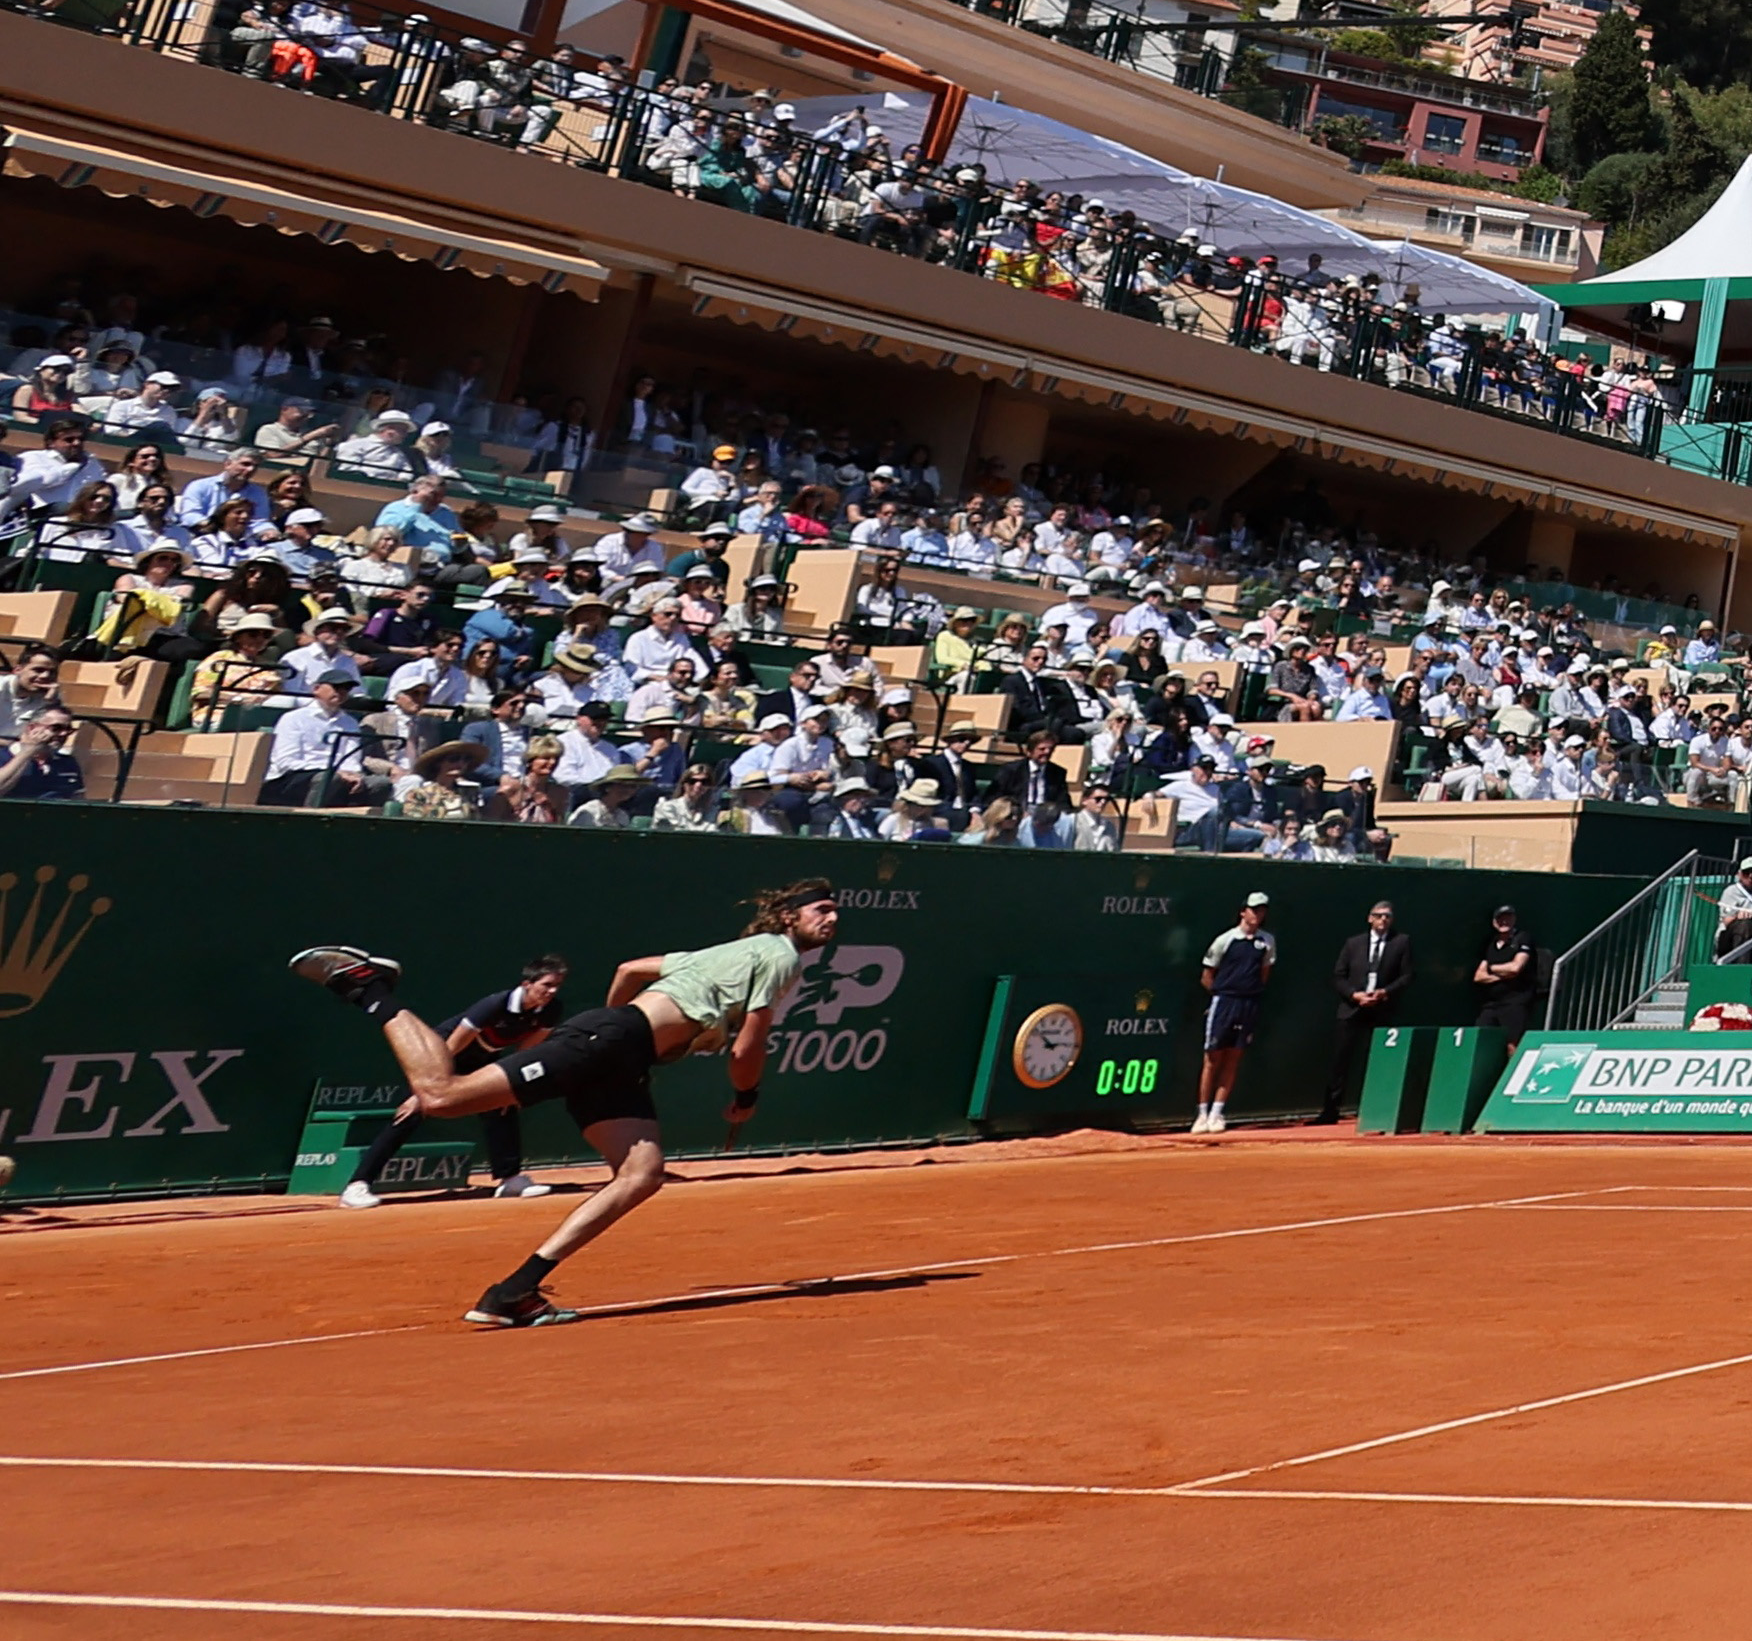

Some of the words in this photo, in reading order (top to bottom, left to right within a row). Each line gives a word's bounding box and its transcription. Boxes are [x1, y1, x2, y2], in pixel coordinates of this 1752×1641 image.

[838, 889, 921, 909] ROLEX
[1102, 895, 1171, 915] ROLEX
[1106, 1018, 1169, 1036] ROLEX
[1385, 1028, 1399, 1047] 2
[1453, 1028, 1464, 1047] 1
[1096, 1059, 1158, 1095] 0:08
[1588, 1057, 1672, 1088] BNP
[0, 1049, 245, 1143] EX
[317, 1086, 399, 1105] REPLAY
[1574, 1099, 1593, 1114] La
[1595, 1099, 1649, 1117] banque
[1651, 1099, 1684, 1115] d'un
[1686, 1099, 1738, 1115] monde
[295, 1153, 337, 1166] REPLAY
[374, 1154, 471, 1184] EPLAY
